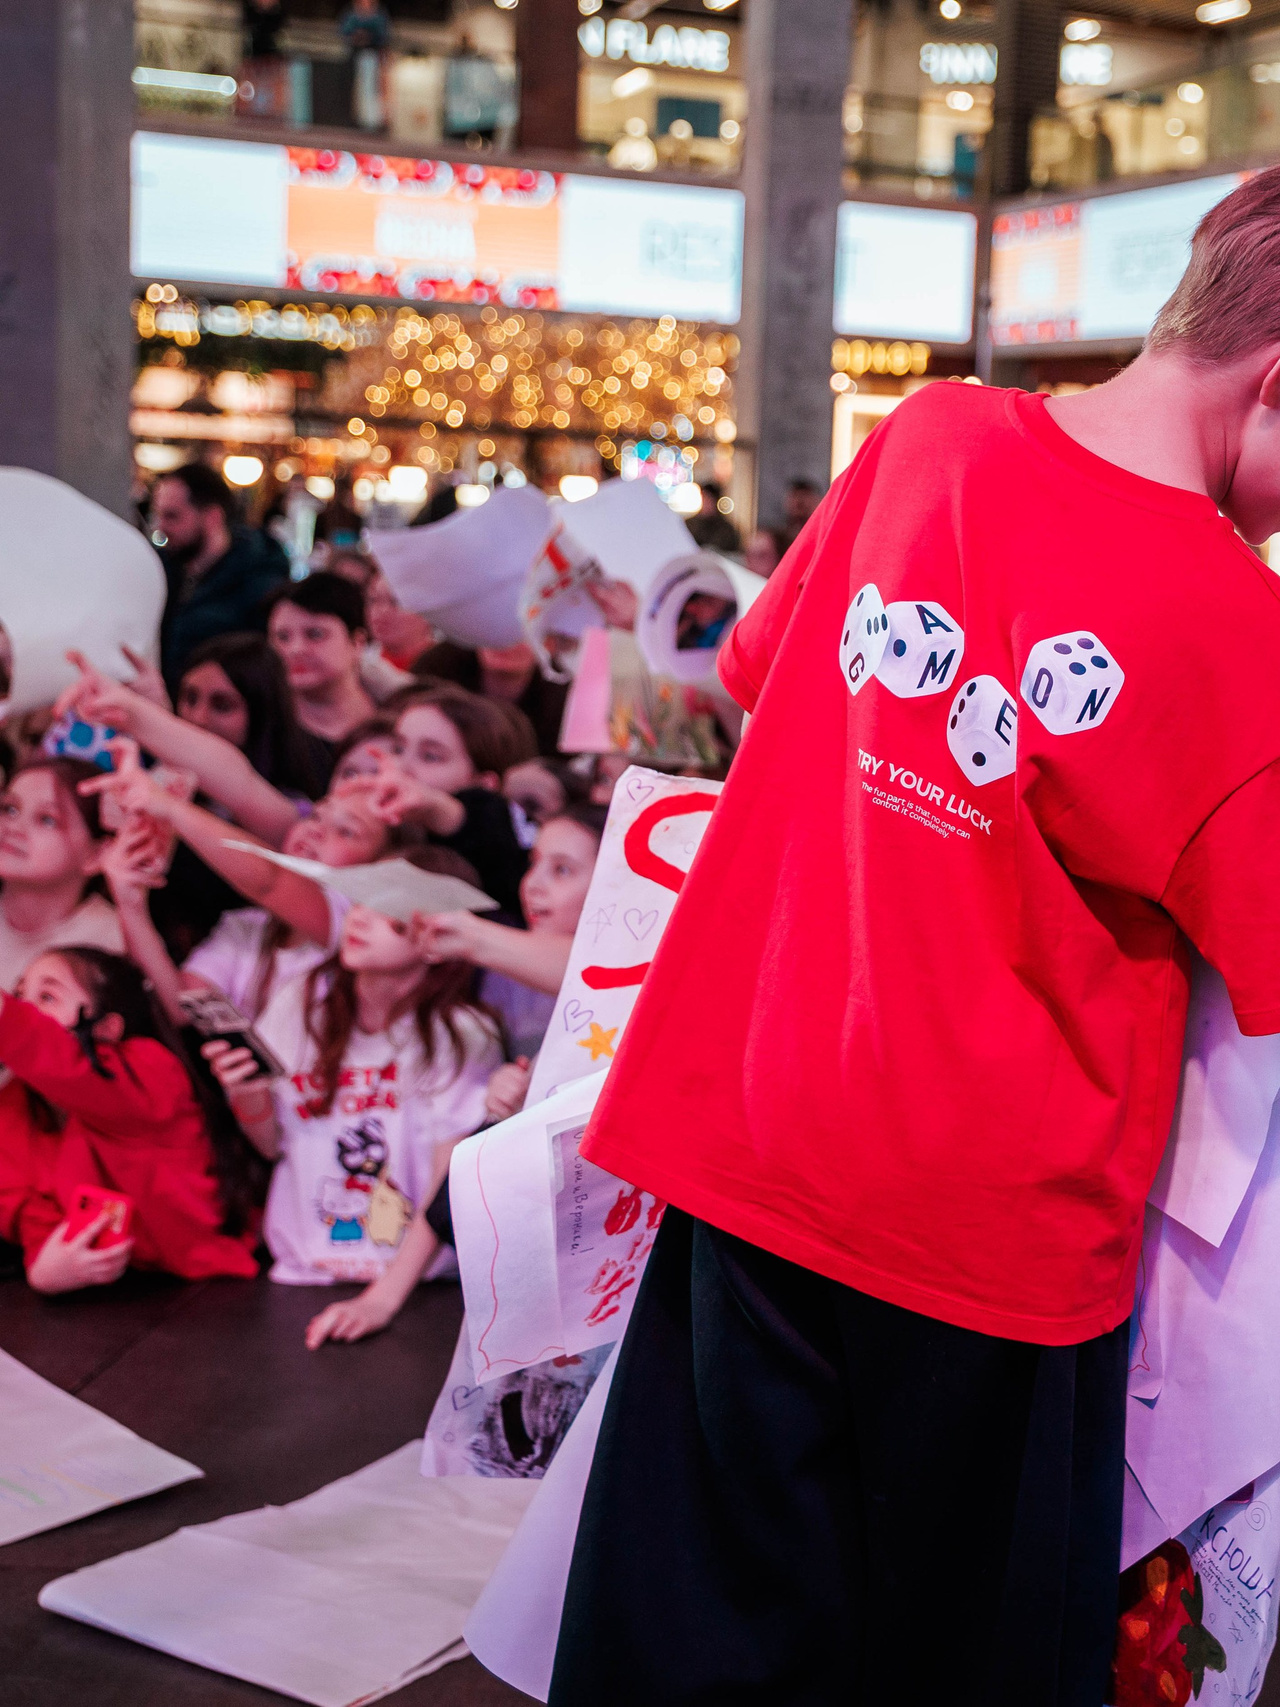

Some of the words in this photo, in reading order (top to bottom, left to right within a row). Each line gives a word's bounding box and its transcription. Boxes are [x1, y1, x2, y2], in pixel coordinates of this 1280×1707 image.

[915, 604, 954, 634] A
[917, 649, 957, 689] M
[994, 698, 1018, 746] E
[858, 748, 884, 775] TRY
[889, 763, 945, 806] YOUR
[945, 794, 993, 835] LUCK
[861, 781, 873, 793] The
[873, 787, 887, 799] fun
[886, 793, 906, 806] part
[907, 800, 914, 810] is
[915, 805, 931, 819] that
[931, 815, 940, 824] no
[941, 821, 956, 832] one
[956, 829, 971, 840] can
[872, 796, 900, 813] control
[901, 806, 909, 816] it
[908, 811, 950, 839] completely.
